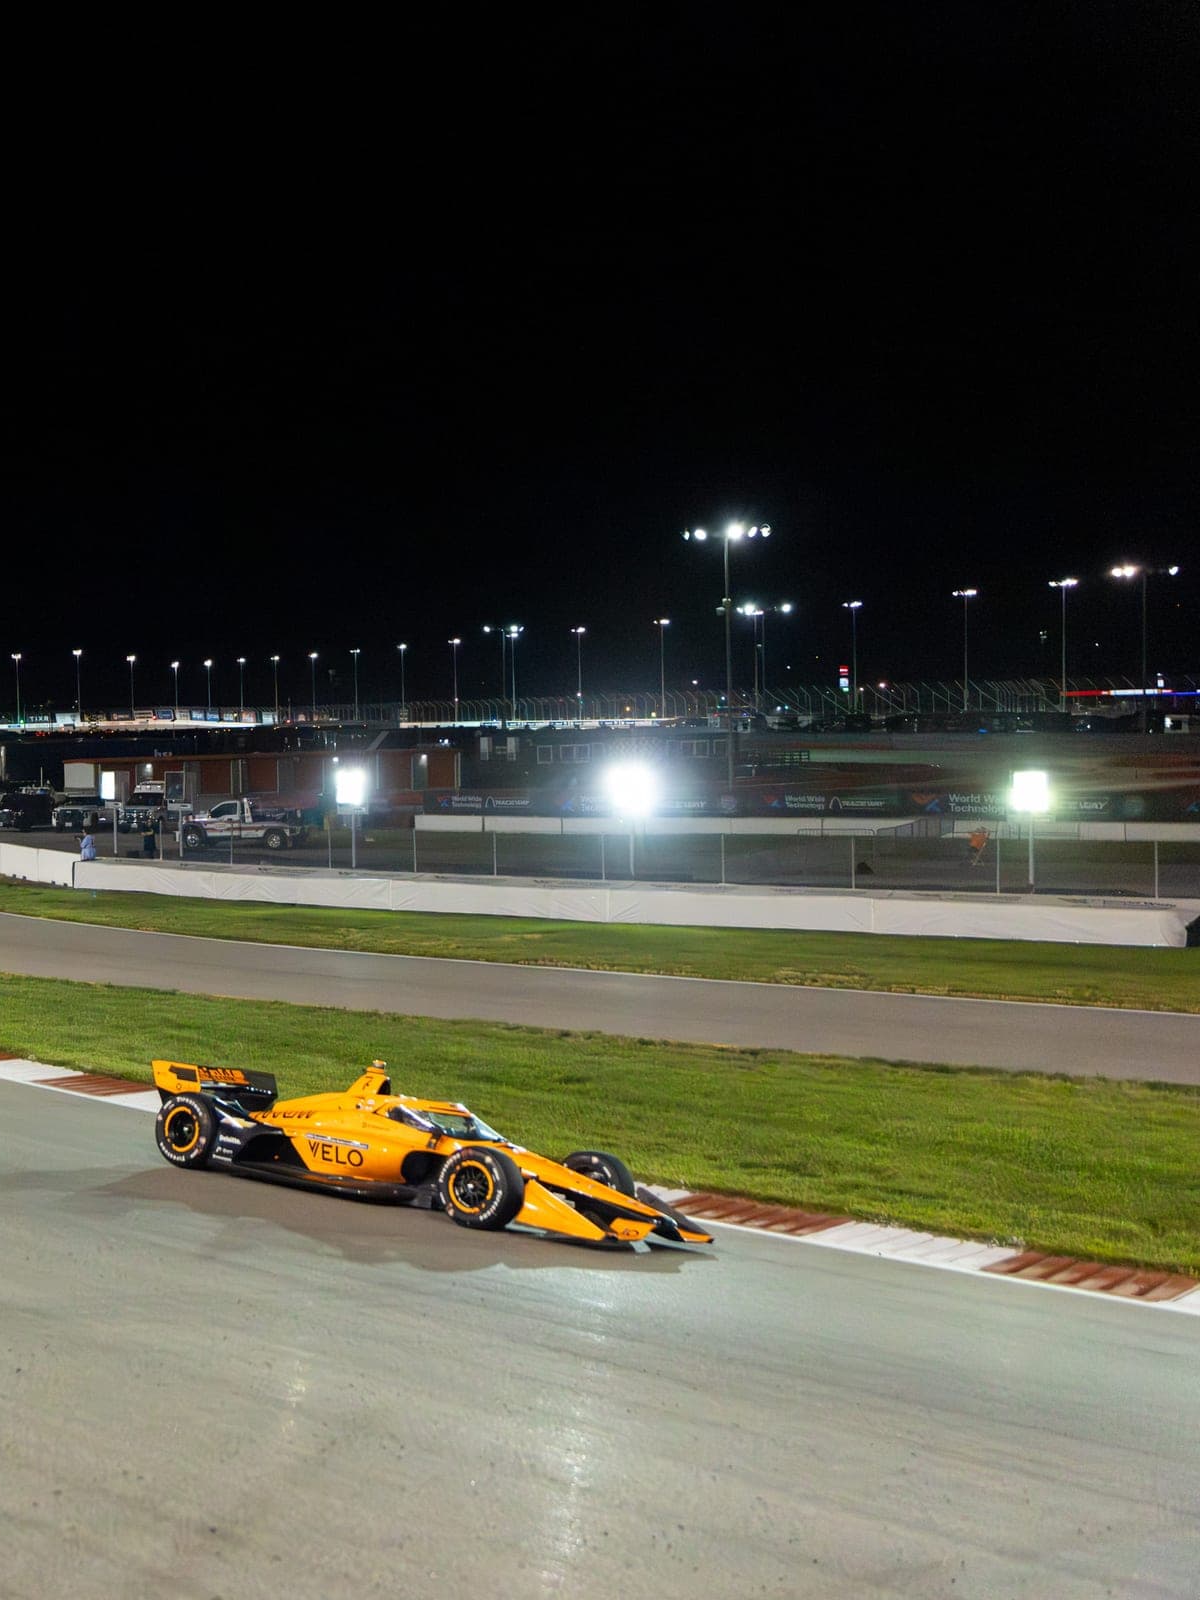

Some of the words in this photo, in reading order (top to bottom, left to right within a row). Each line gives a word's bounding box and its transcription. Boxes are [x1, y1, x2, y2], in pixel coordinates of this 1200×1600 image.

[949, 793, 981, 803] World
[949, 803, 1006, 816] Technolog
[308, 1139, 364, 1168] VELO
